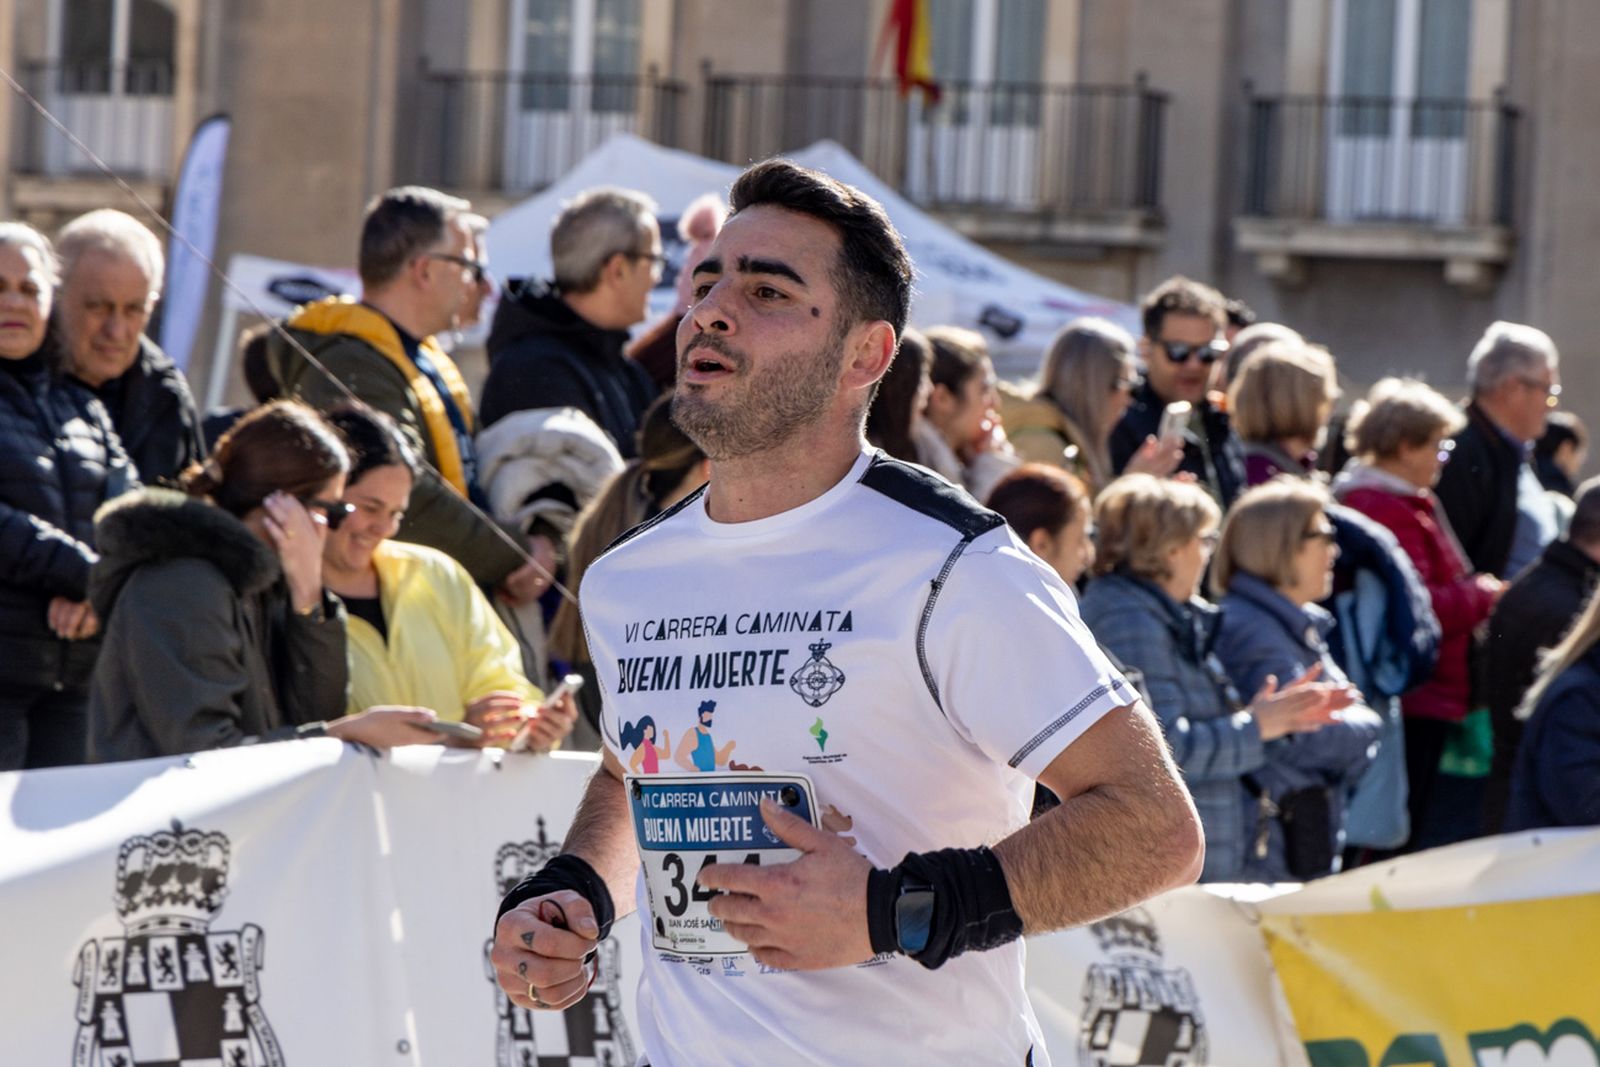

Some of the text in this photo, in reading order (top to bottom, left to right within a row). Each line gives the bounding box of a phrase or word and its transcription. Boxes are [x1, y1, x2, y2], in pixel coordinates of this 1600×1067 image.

[625, 610, 853, 643] VI CARRERA CAMINATA
[617, 649, 789, 693] BUENA MUERTE
[641, 793, 650, 808] VI
[651, 791, 706, 808] CARRERA
[643, 815, 753, 842] BUENA MUERTE
[662, 852, 760, 917] 34
